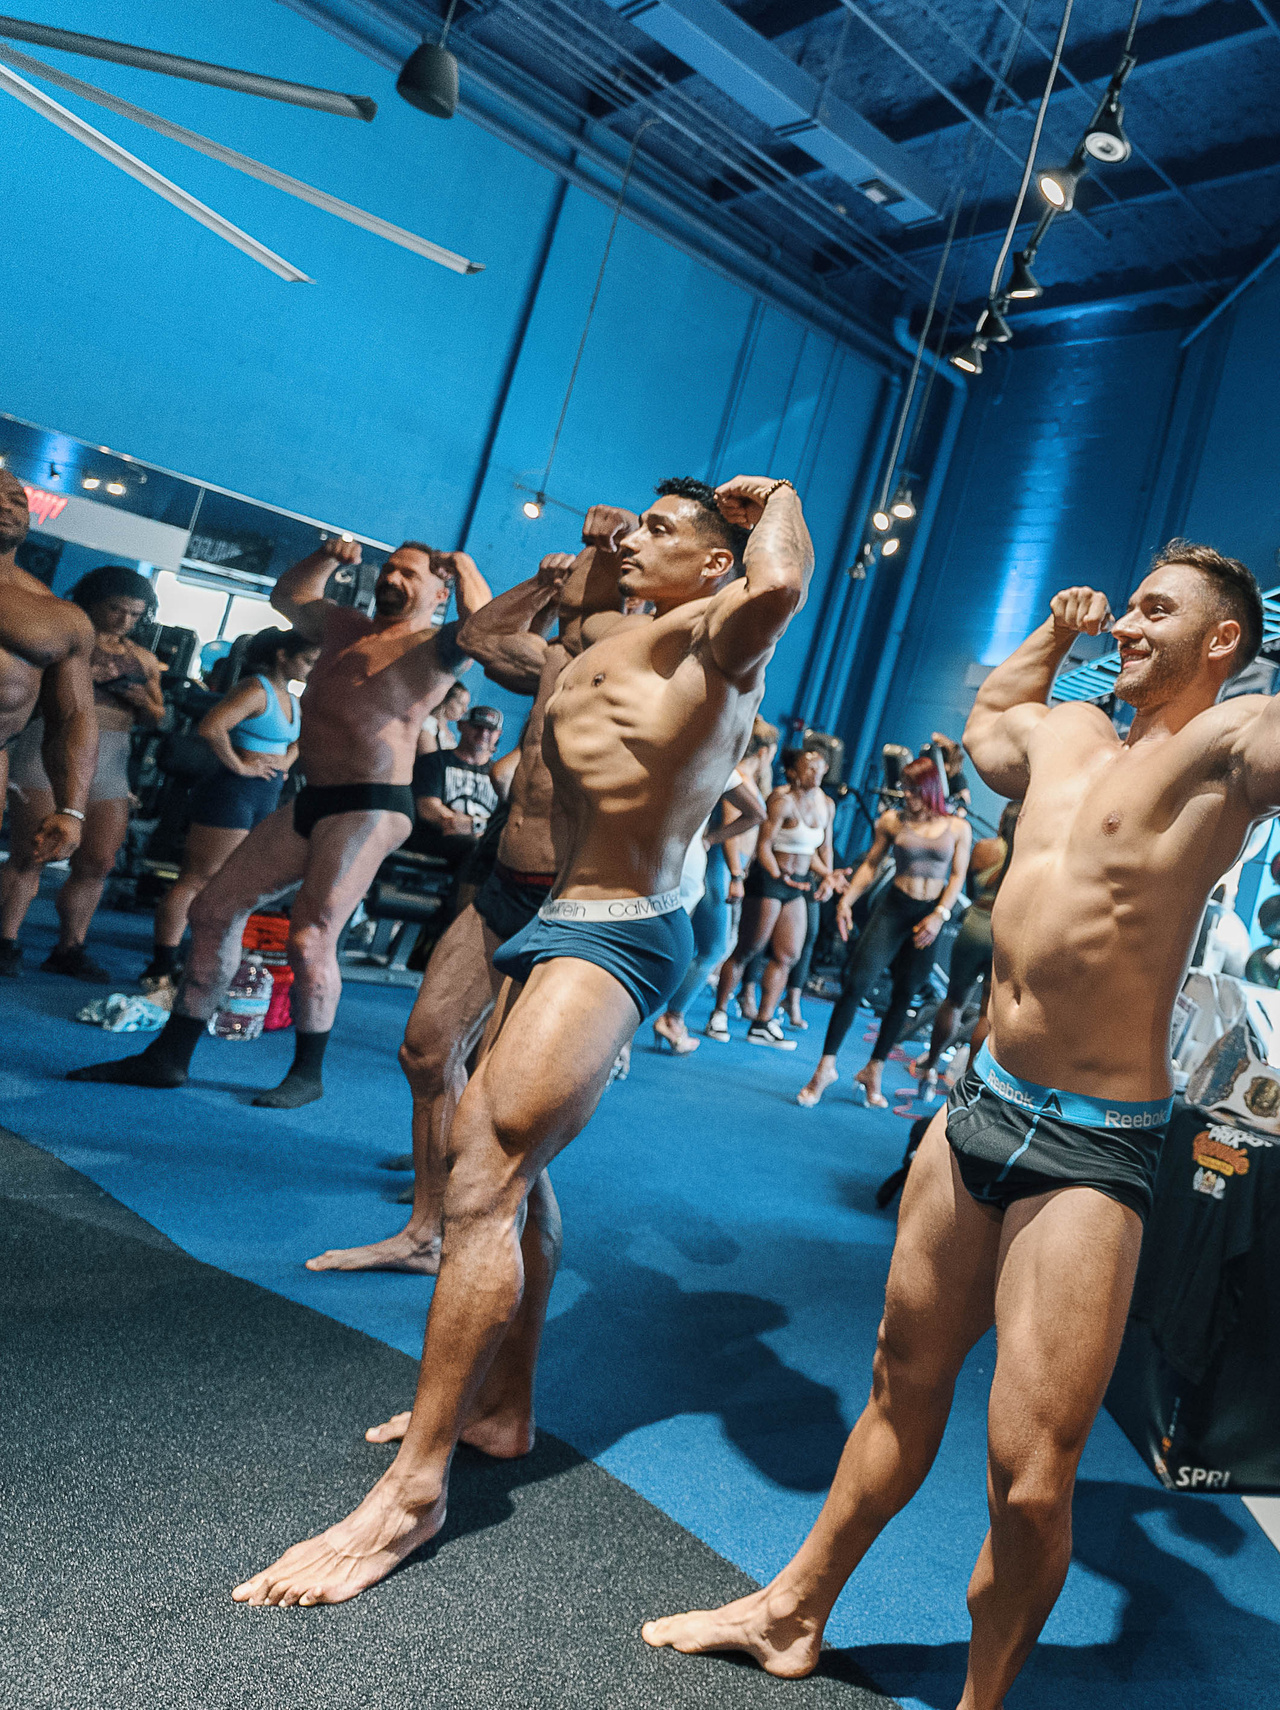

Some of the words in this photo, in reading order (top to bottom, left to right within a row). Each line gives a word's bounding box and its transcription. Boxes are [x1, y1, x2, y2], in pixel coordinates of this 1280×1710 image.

[986, 1069, 1035, 1109] Reebok
[1104, 1110, 1168, 1128] Reebok
[1176, 1466, 1231, 1488] SPRI
